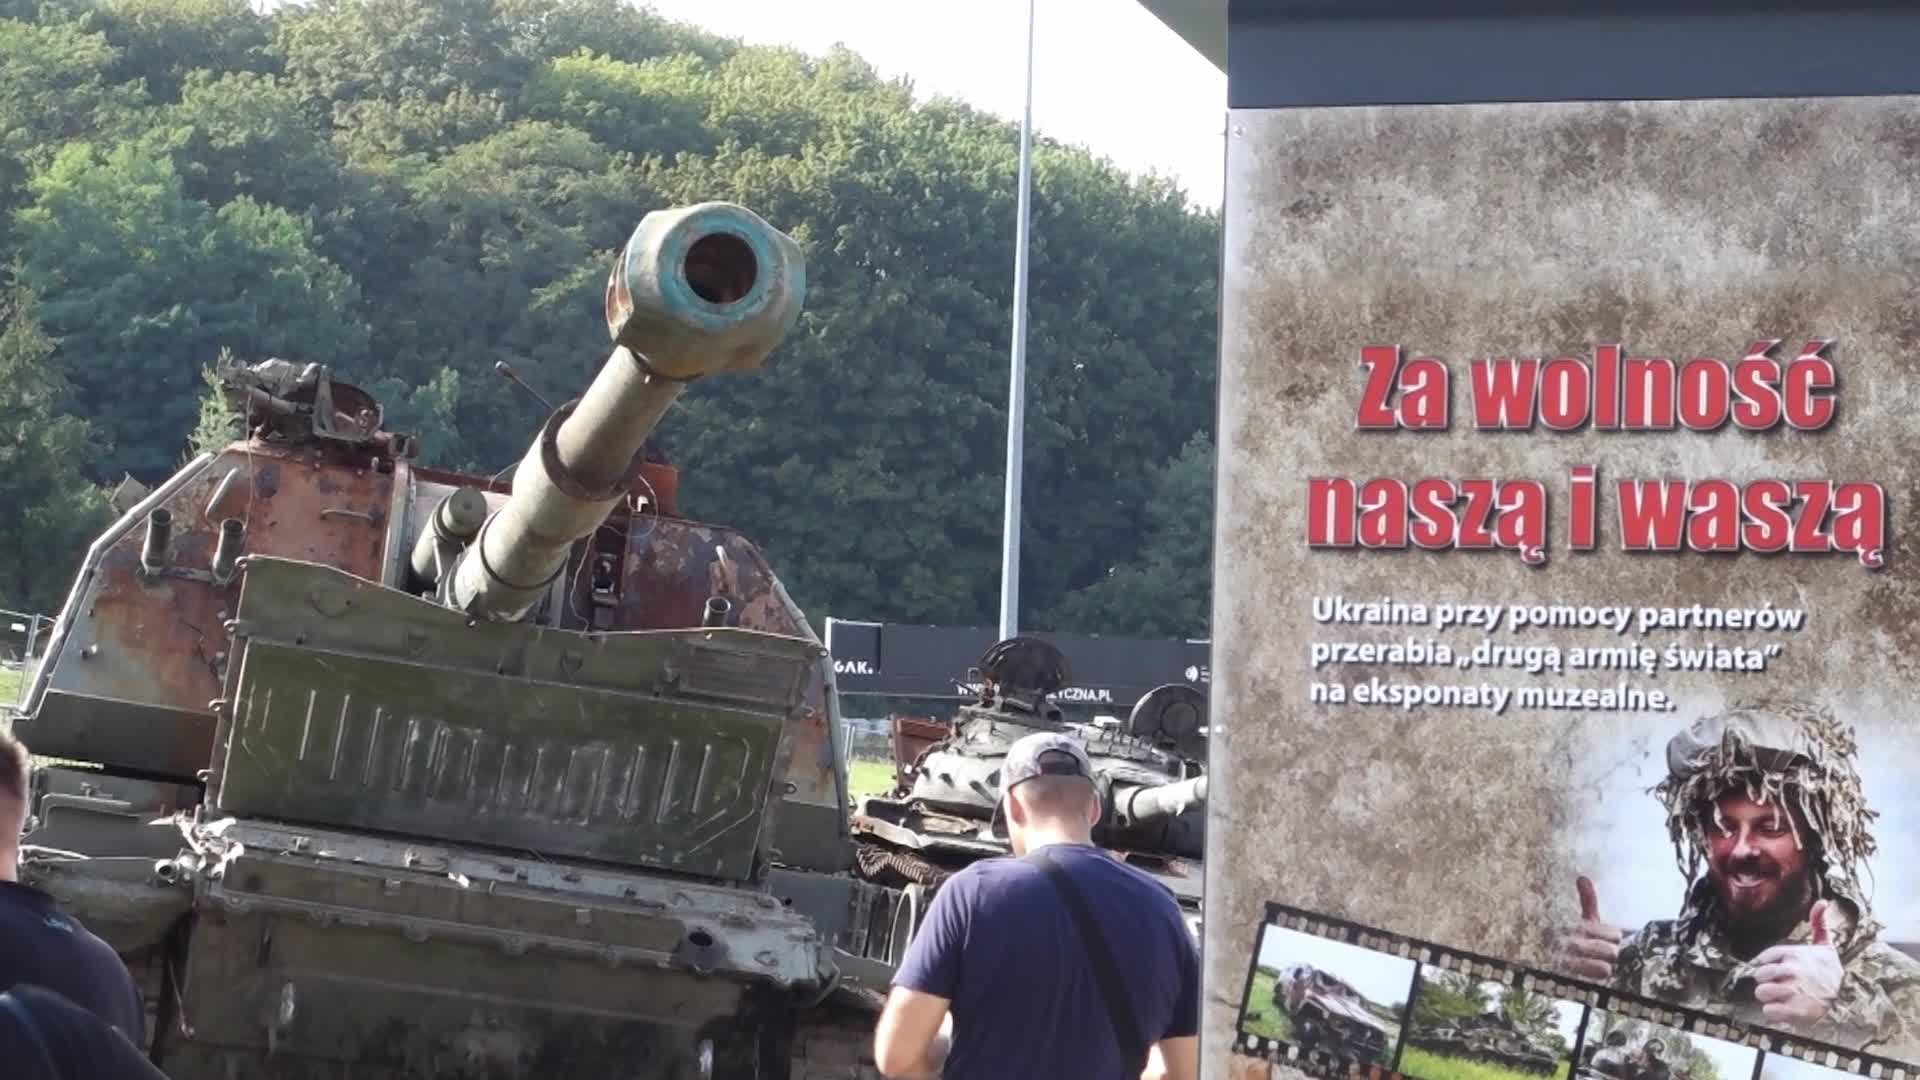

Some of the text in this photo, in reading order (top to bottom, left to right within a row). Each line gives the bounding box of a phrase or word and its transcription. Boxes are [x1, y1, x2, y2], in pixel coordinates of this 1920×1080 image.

[1356, 338, 1839, 432] Za wolność
[1307, 464, 1886, 568] naszą i waszą
[1312, 597, 1805, 633] Ukraina przy pomocy partnerów
[1311, 638, 1453, 668] przerabia
[1568, 643, 1659, 676] armię
[1310, 677, 1677, 713] na eksponaty muzealne.
